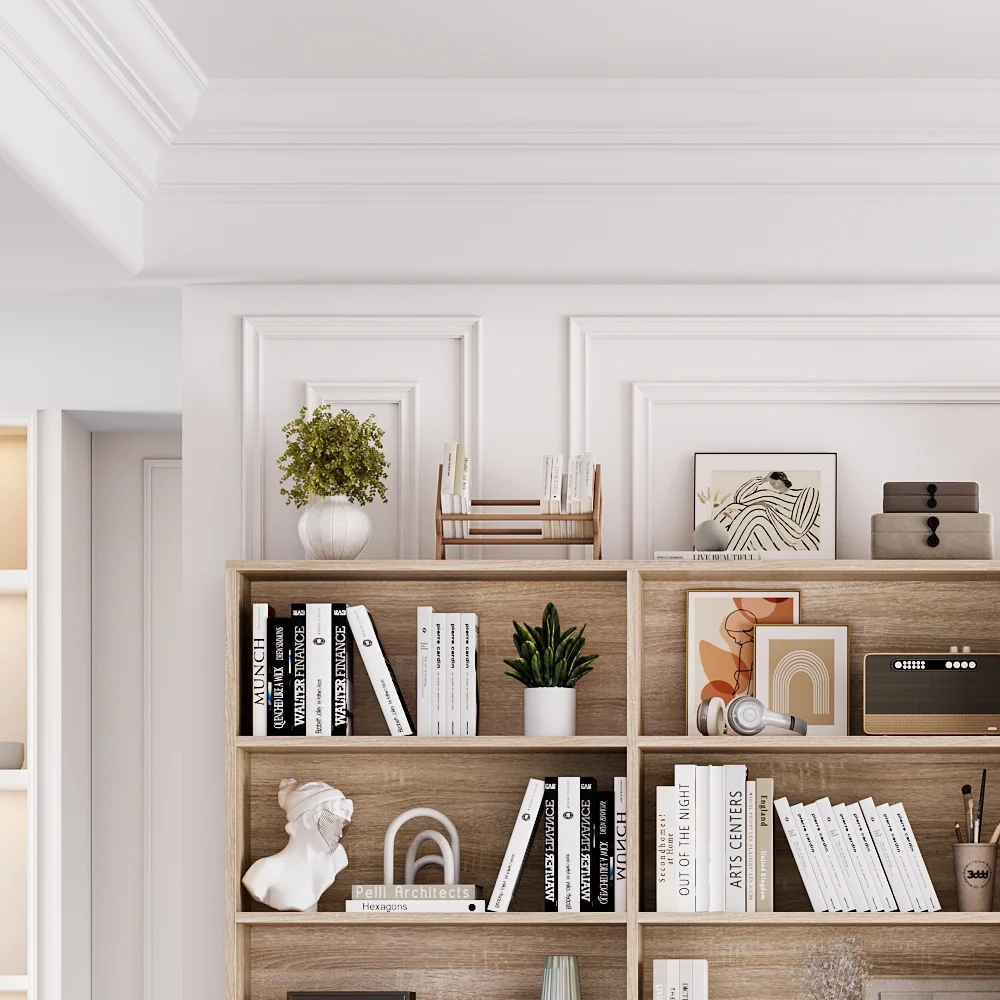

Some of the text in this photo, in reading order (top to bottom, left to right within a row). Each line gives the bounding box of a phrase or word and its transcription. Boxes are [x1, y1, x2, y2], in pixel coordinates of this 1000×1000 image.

[253, 638, 265, 706] MUNCH
[294, 626, 305, 678] FINANCE
[335, 626, 346, 678] FINANCE
[294, 679, 306, 727] WALTER
[335, 679, 346, 727] WALTER
[759, 795, 768, 827] England
[679, 783, 690, 896] OUT OF THE NIGHT
[730, 790, 742, 889] ARTS CENTERS
[356, 885, 470, 899] Pelli Architects
[760, 870, 768, 901] Kingdom
[967, 869, 989, 879] 3ddd
[362, 903, 408, 912] Hexagons
